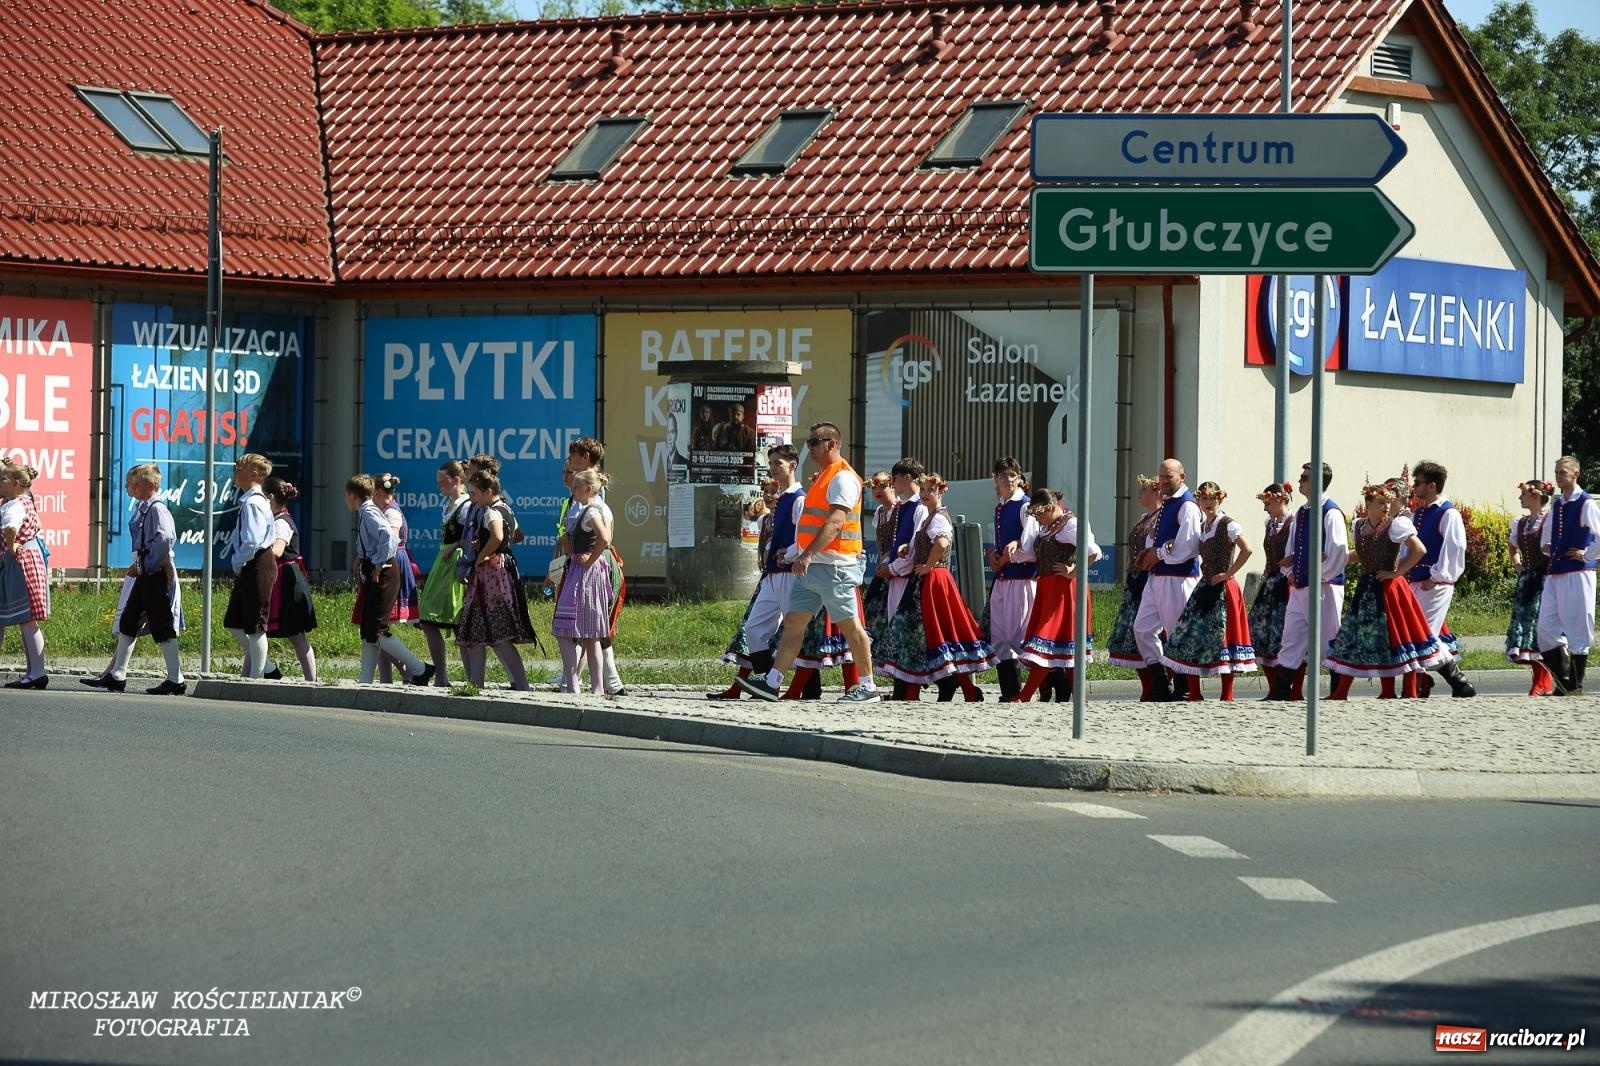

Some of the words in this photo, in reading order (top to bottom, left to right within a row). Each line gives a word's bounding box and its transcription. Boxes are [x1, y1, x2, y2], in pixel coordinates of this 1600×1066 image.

[1121, 130, 1294, 164] Centrum
[1058, 207, 1333, 265] Głubczyce
[1361, 287, 1515, 351] ŁAZIENKI
[967, 336, 1039, 365] Salon
[233, 369, 261, 395] 3D
[383, 340, 576, 401] PŁYTKI
[890, 356, 933, 391] tgs
[964, 374, 1081, 404] Łazienek
